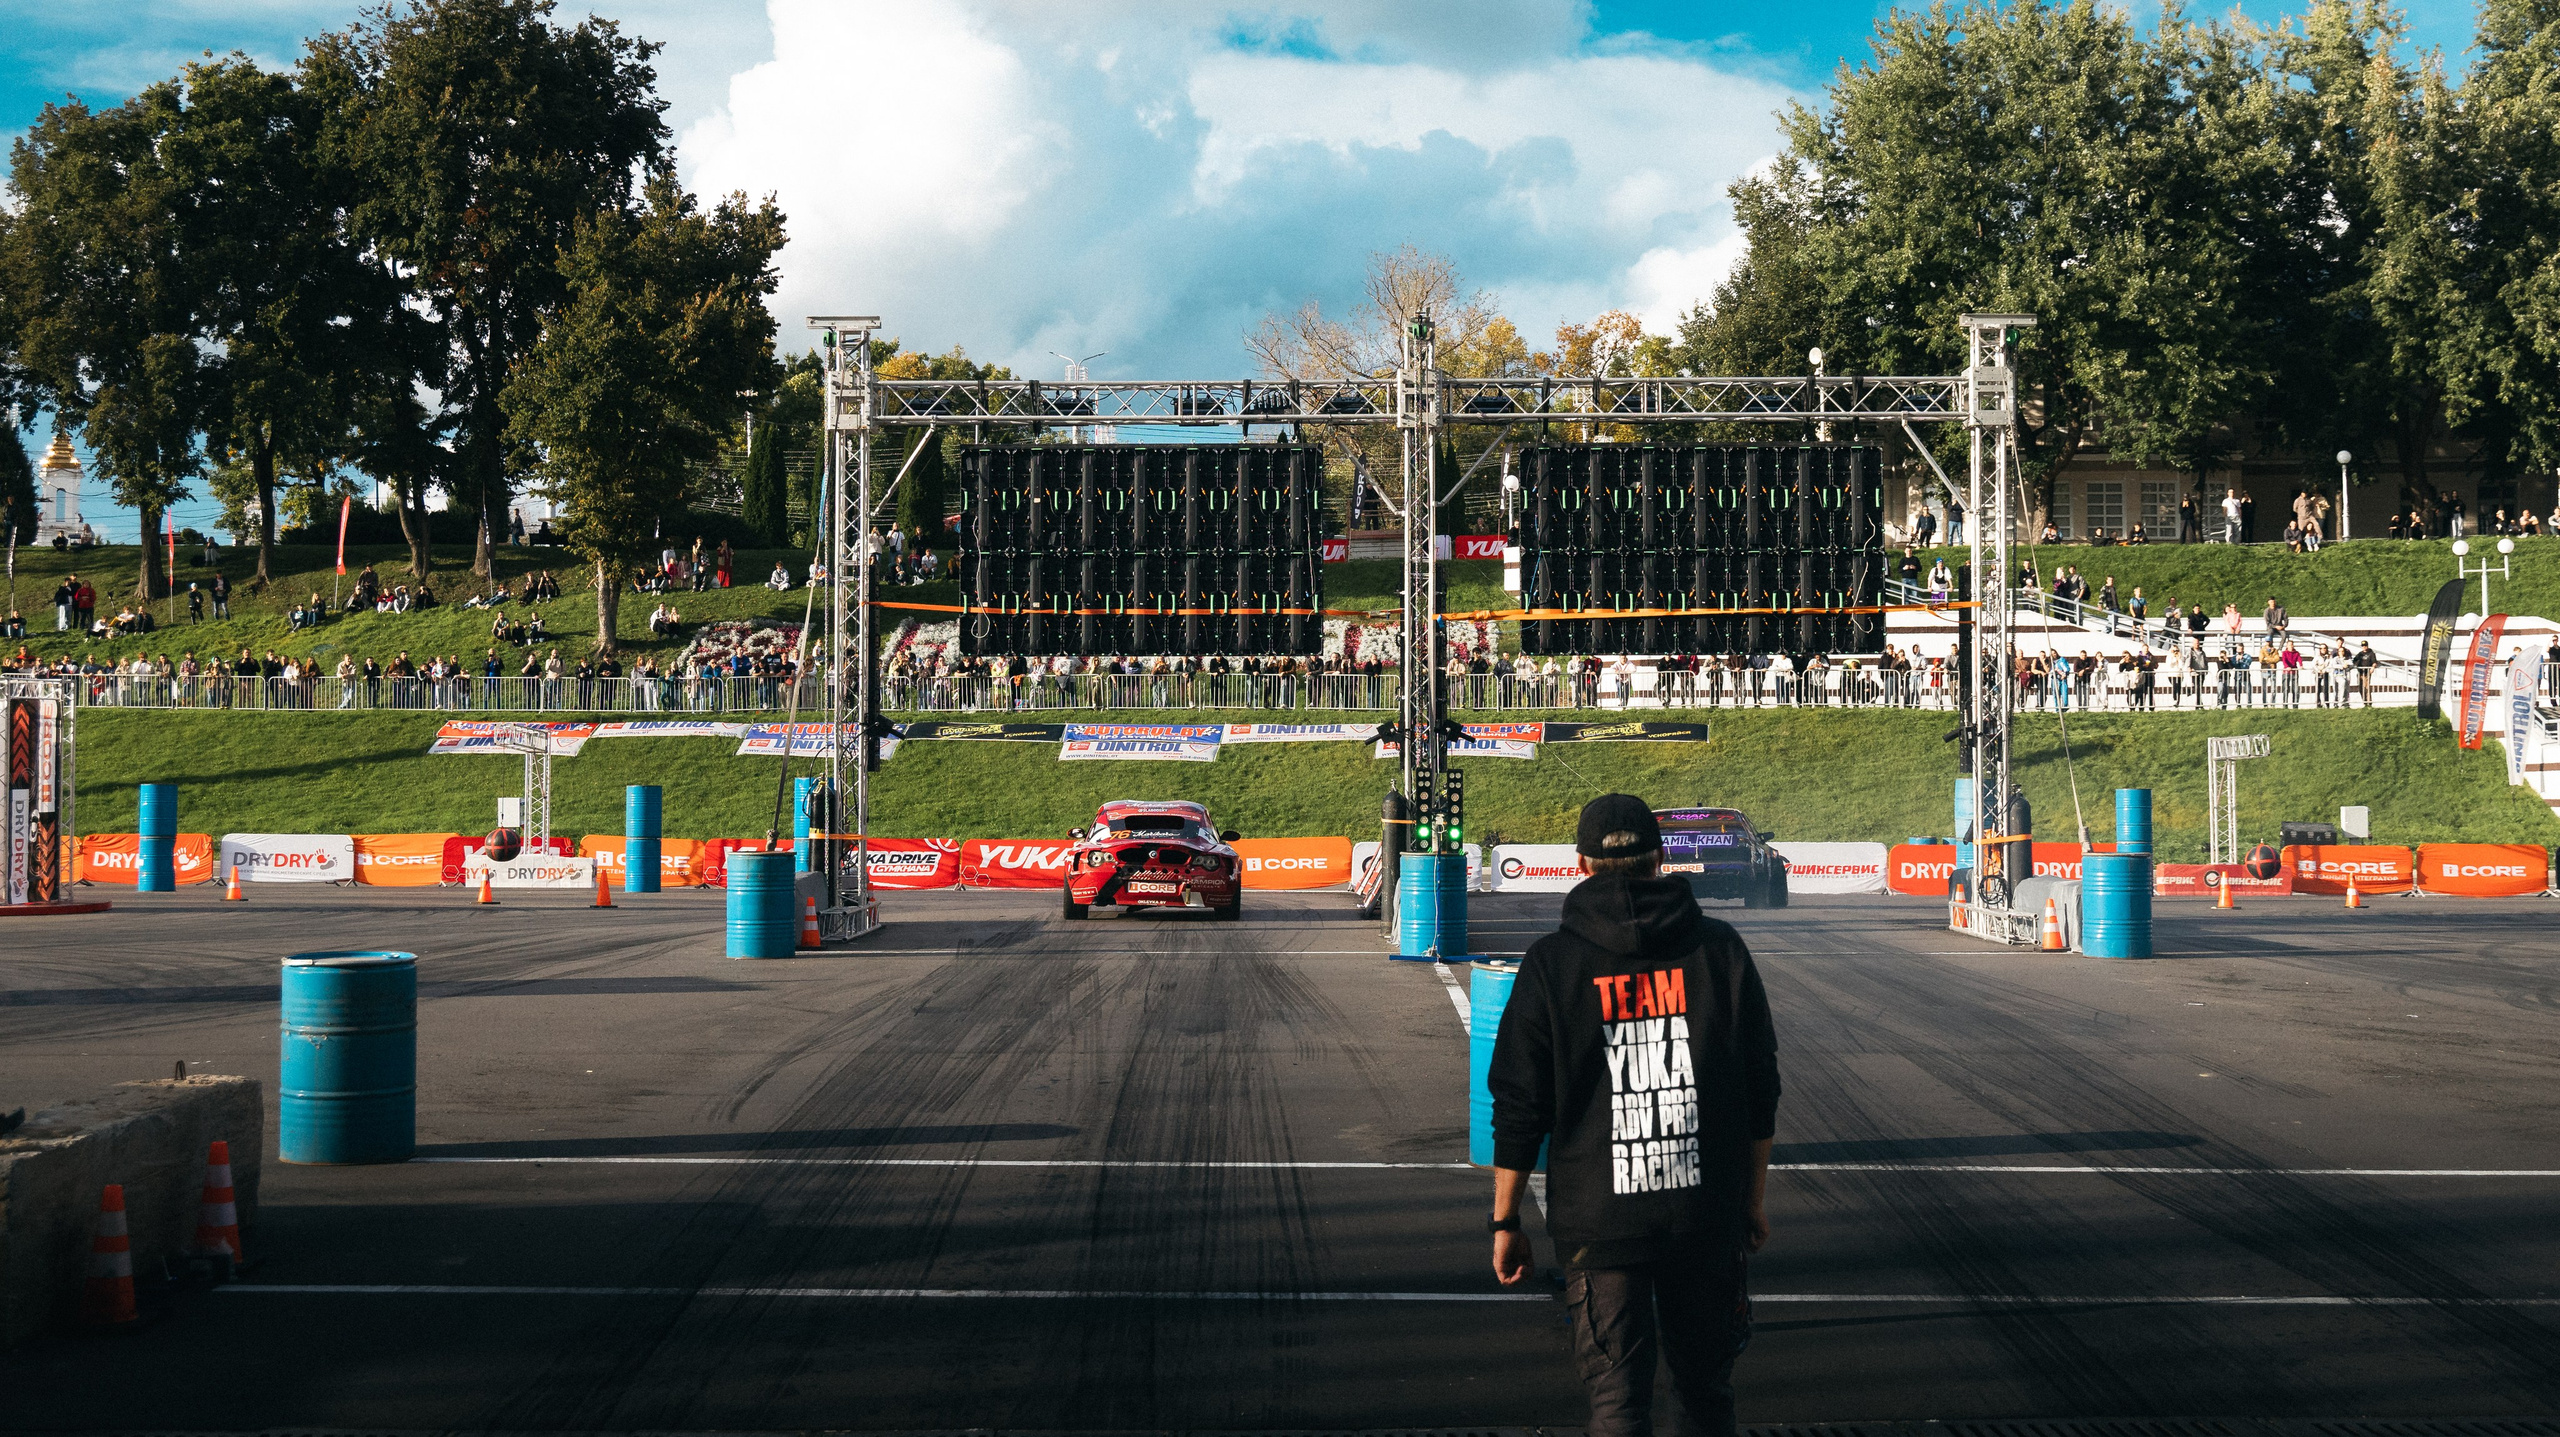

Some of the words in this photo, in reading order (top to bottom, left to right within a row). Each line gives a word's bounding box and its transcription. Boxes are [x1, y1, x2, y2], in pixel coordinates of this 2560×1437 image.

[1467, 541, 1508, 556] YUK
[2466, 637, 2494, 735] AUTORUL.BY
[630, 721, 715, 730] DINITROL
[1084, 725, 1207, 737] AUTORUL.BY
[1257, 725, 1346, 734] DINITROL
[2512, 692, 2532, 774] DINITROL
[1095, 741, 1183, 752] DINITROL
[15, 800, 25, 875] DRYDRY
[1110, 829, 1132, 840] 76
[1662, 835, 1733, 847] AMIL_KHAN
[93, 851, 140, 869] DRY
[233, 851, 314, 868] DRYDRY
[617, 853, 691, 868] CRE
[889, 854, 938, 864] DRIVE
[508, 868, 566, 880] DRYDRY
[876, 865, 931, 873] GYMKHANA
[1526, 867, 1588, 877] ШИНСЕР
[1793, 864, 1879, 875] ШИНСЕРВИС
[1901, 862, 1956, 879] DRYD
[2034, 862, 2083, 879] DRYD
[1593, 968, 1687, 1021] TEAM
[1602, 1016, 1695, 1093] YUKA
[1611, 1092, 1653, 1141] ADV
[1657, 1087, 1699, 1137] PRO
[1612, 1137, 1701, 1195] RACING
